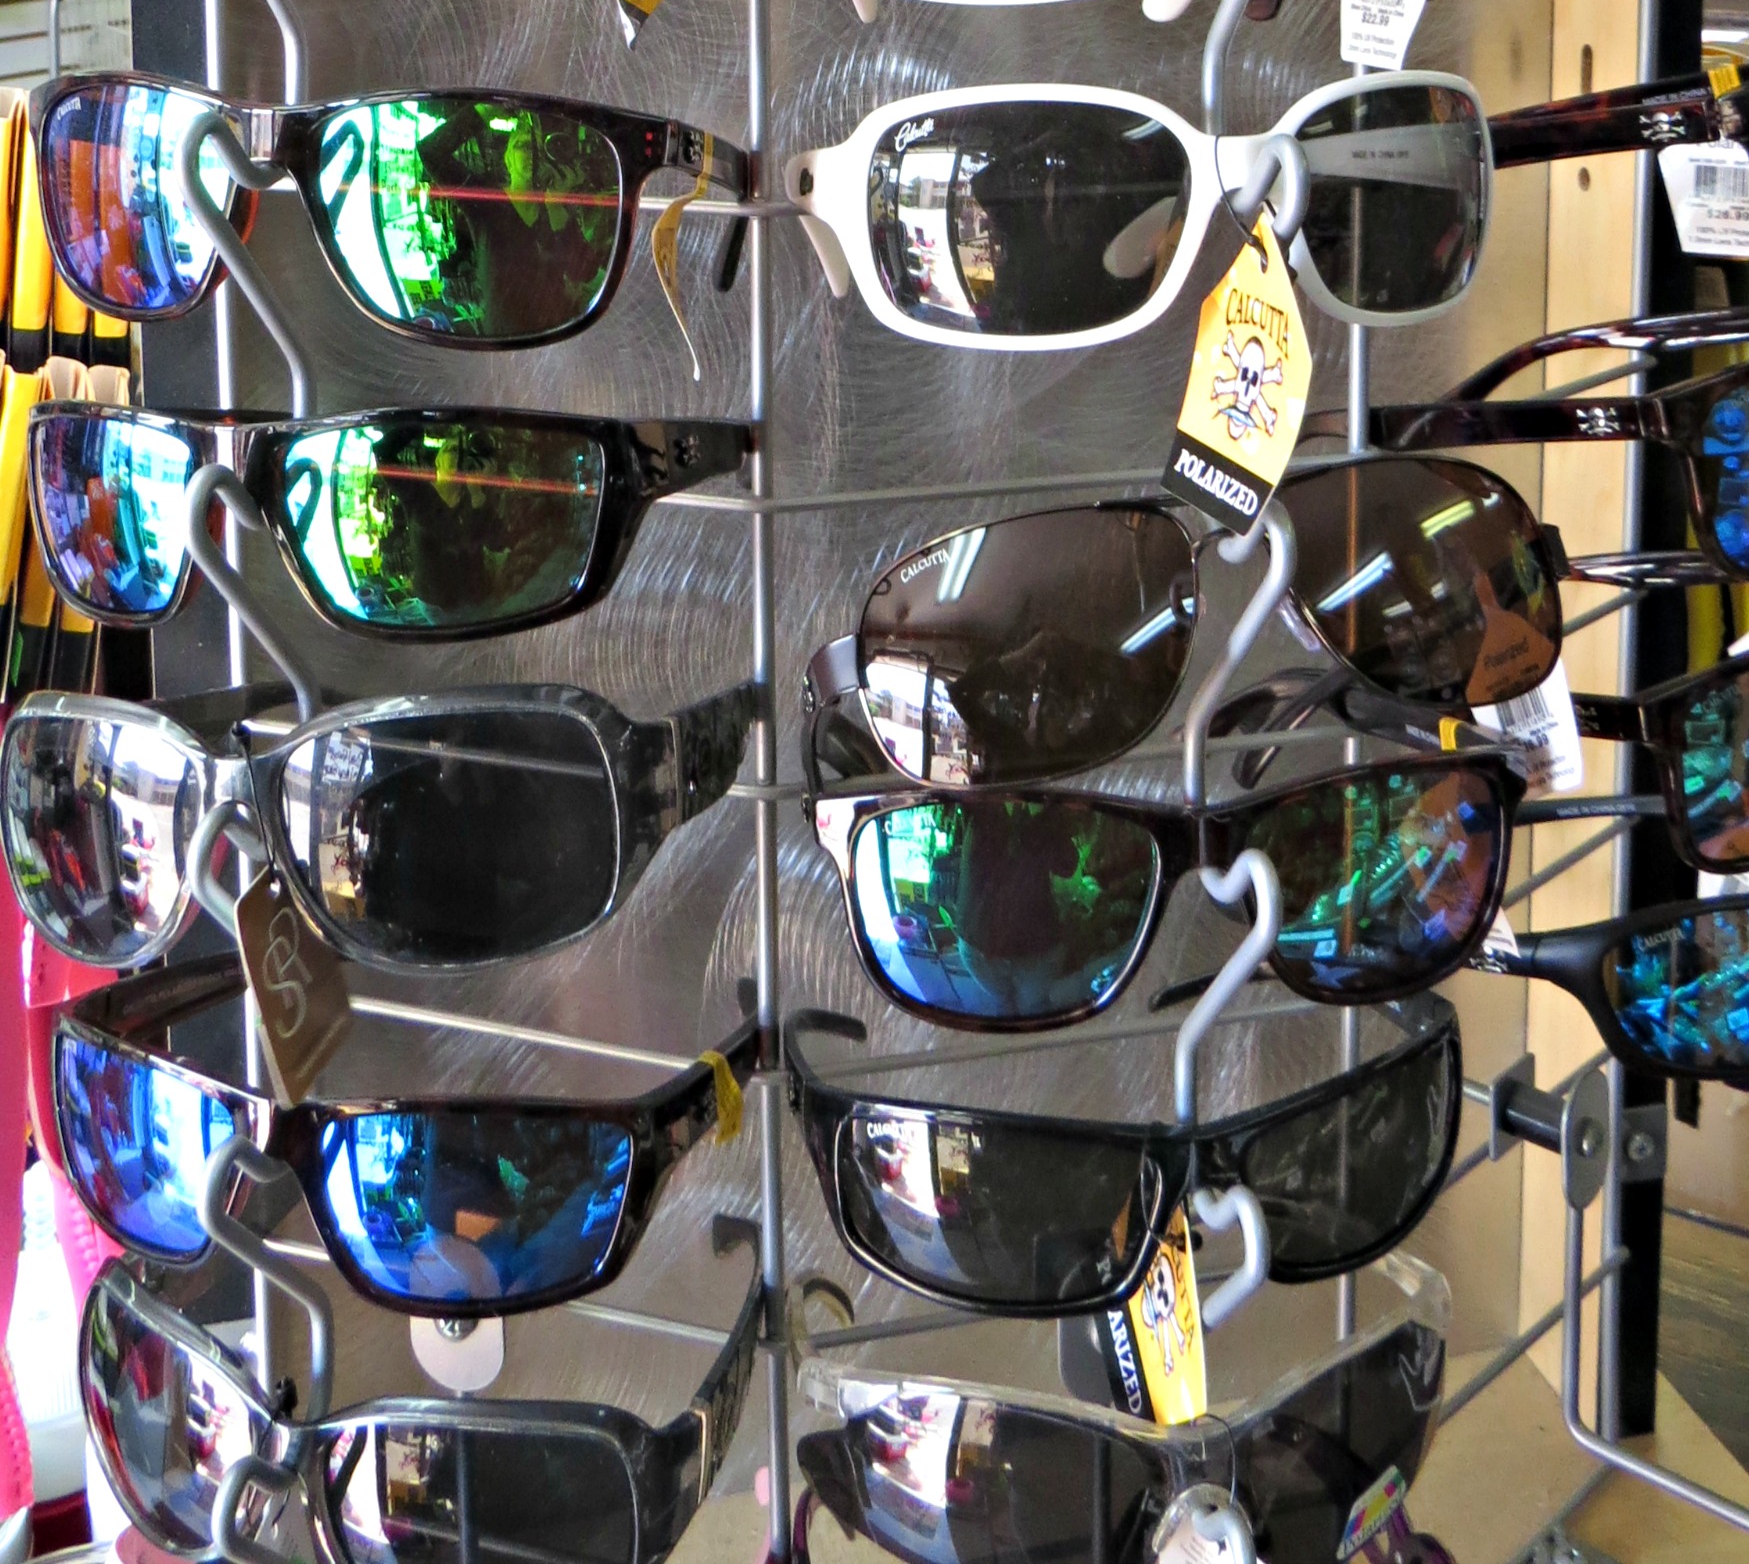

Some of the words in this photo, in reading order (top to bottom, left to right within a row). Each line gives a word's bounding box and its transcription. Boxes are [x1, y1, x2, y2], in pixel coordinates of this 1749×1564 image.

[893, 117, 934, 153] Calcutta
[1225, 286, 1290, 360] CALCUTTA
[1174, 446, 1259, 517] POLARIZED
[900, 547, 951, 584] CALCUTTA
